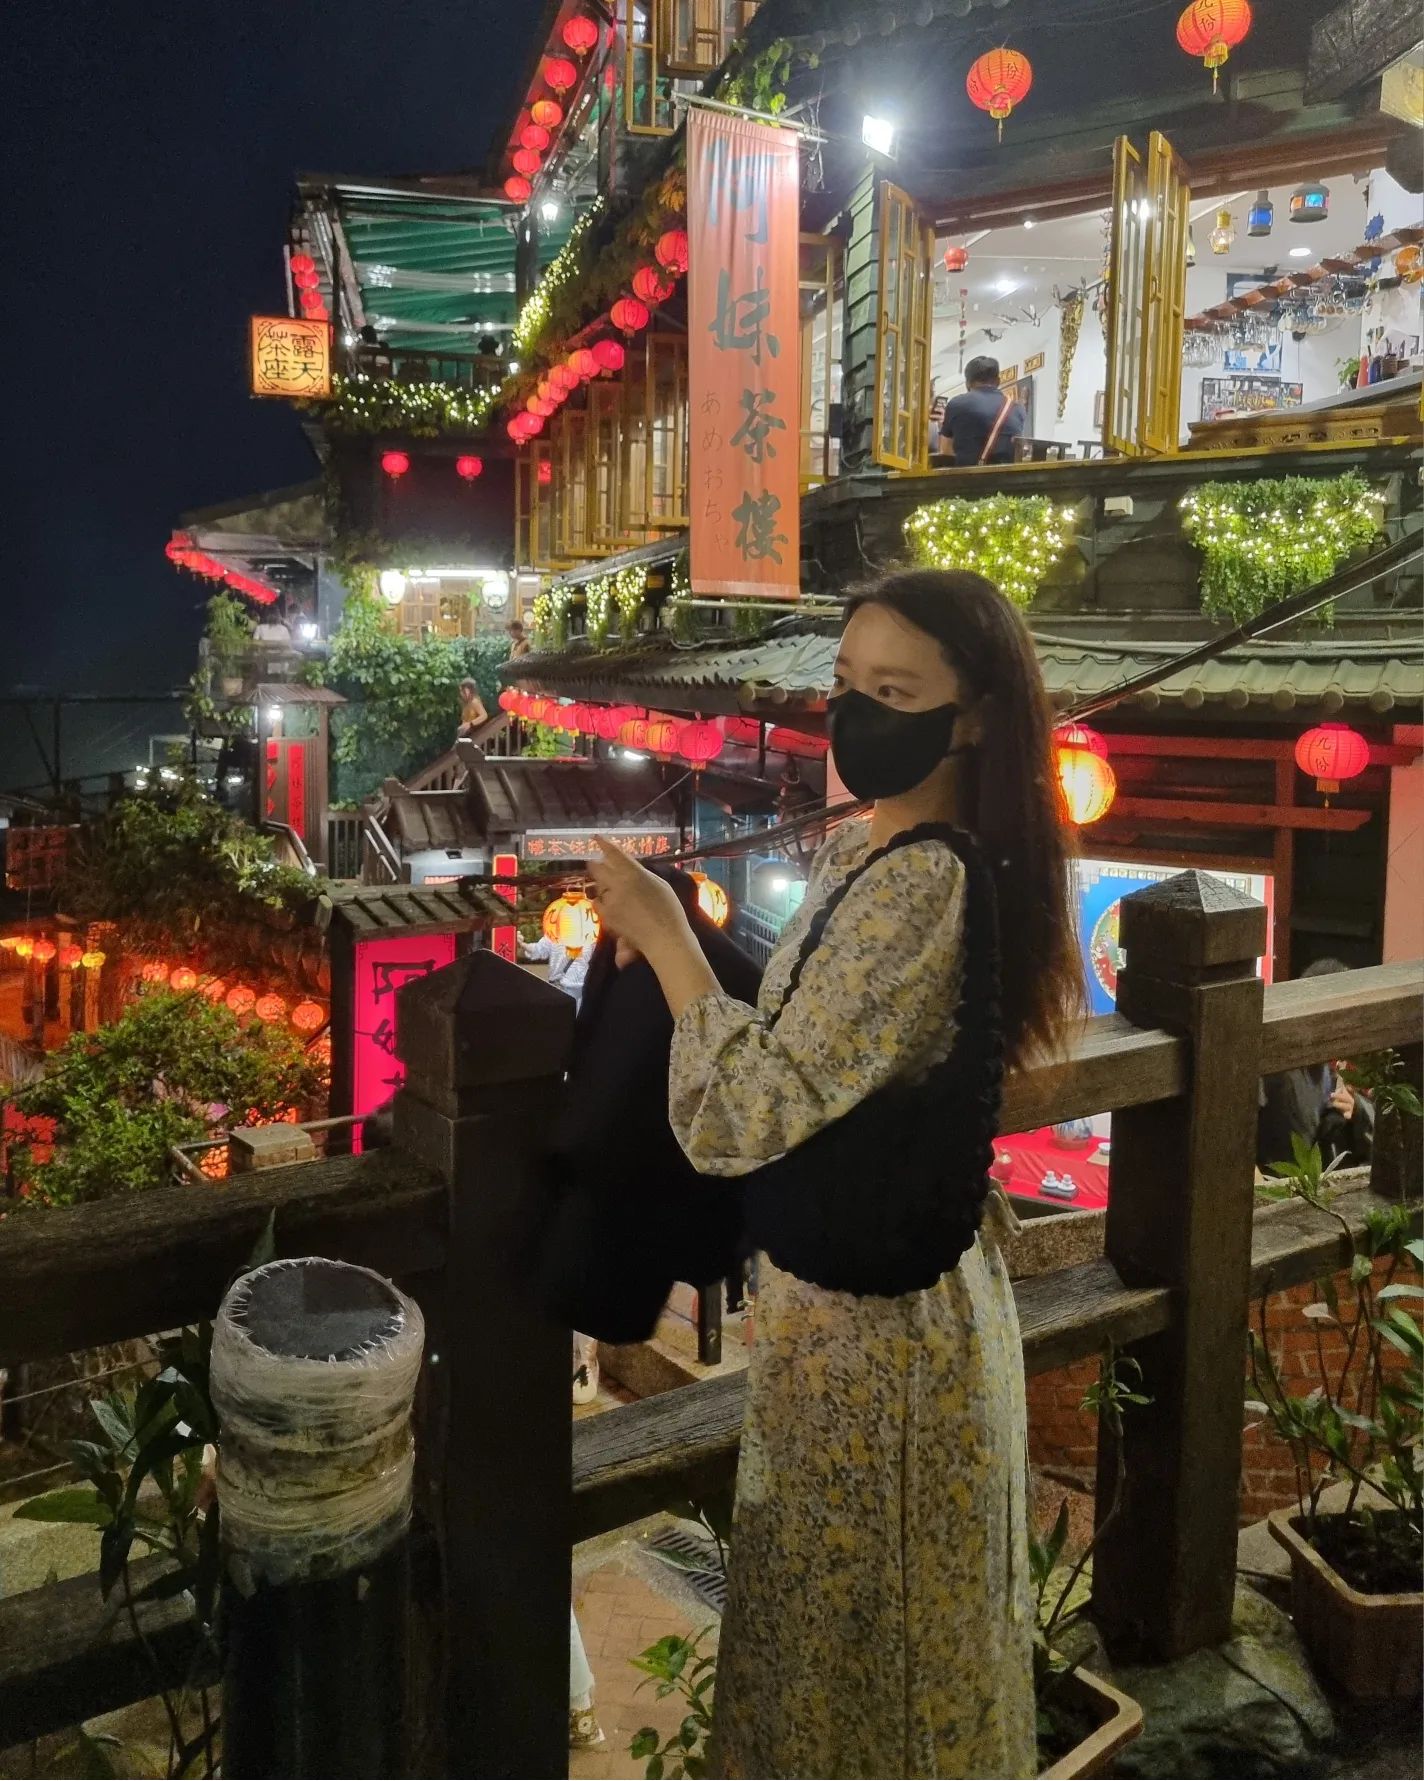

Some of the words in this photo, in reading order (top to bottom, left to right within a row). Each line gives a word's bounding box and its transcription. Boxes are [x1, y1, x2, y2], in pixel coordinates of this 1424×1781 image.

[700, 390, 730, 553] あめおちゃ
[702, 135, 791, 566] 阿妹茶樓
